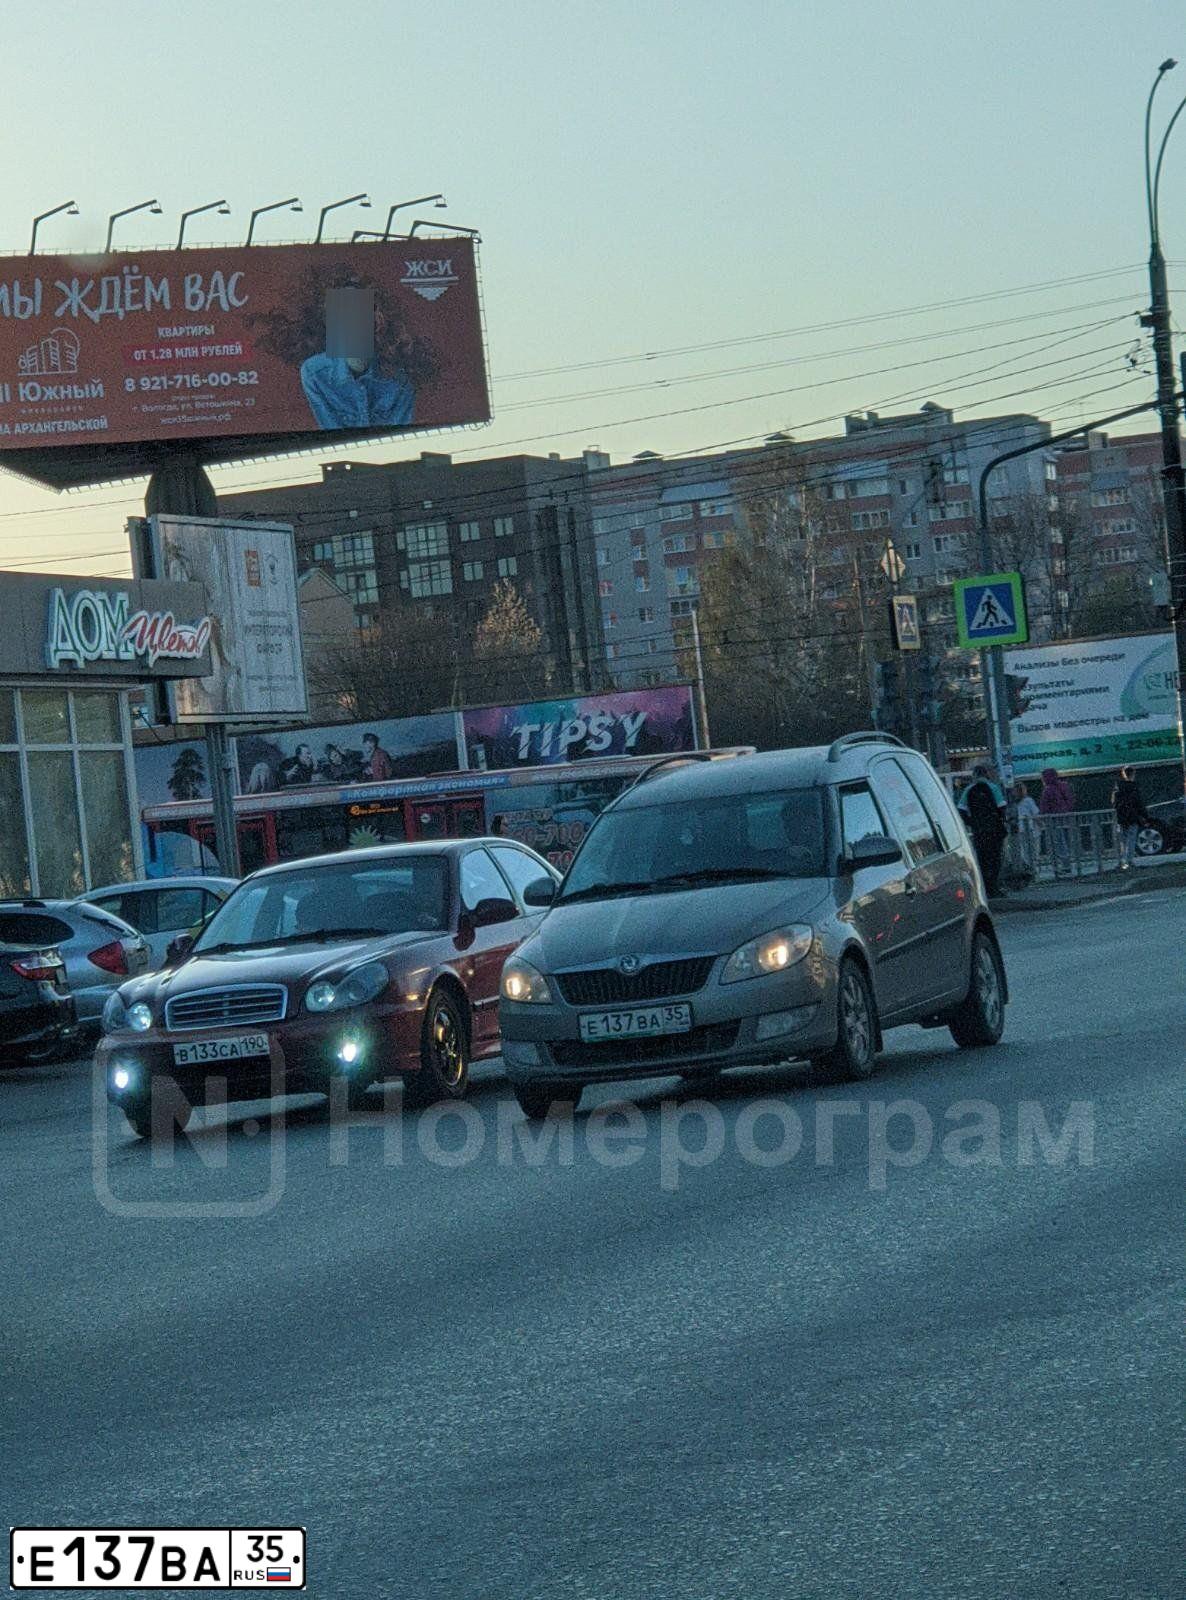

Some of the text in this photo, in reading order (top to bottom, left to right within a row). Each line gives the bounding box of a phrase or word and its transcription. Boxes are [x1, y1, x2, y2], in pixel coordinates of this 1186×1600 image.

[404, 259, 453, 276] ЖСИ
[54, 265, 171, 323] ЖДЁМ
[184, 271, 249, 313] ВАС
[158, 325, 215, 337] КВАРТИРЫ
[133, 350, 147, 360] ОТ
[175, 346, 199, 358] МЛН
[201, 342, 243, 356] РУБЛЕЙ
[18, 378, 105, 401] Южный
[124, 371, 259, 392] 8 921-716-00-82
[14, 415, 108, 434] АРХАНГЕЛЬСКОЙ
[49, 588, 134, 668] ДОМ
[509, 710, 647, 760] TIPSY
[588, 1006, 683, 1035] Е137ВА 35
[180, 1036, 264, 1062] В133СА 190
